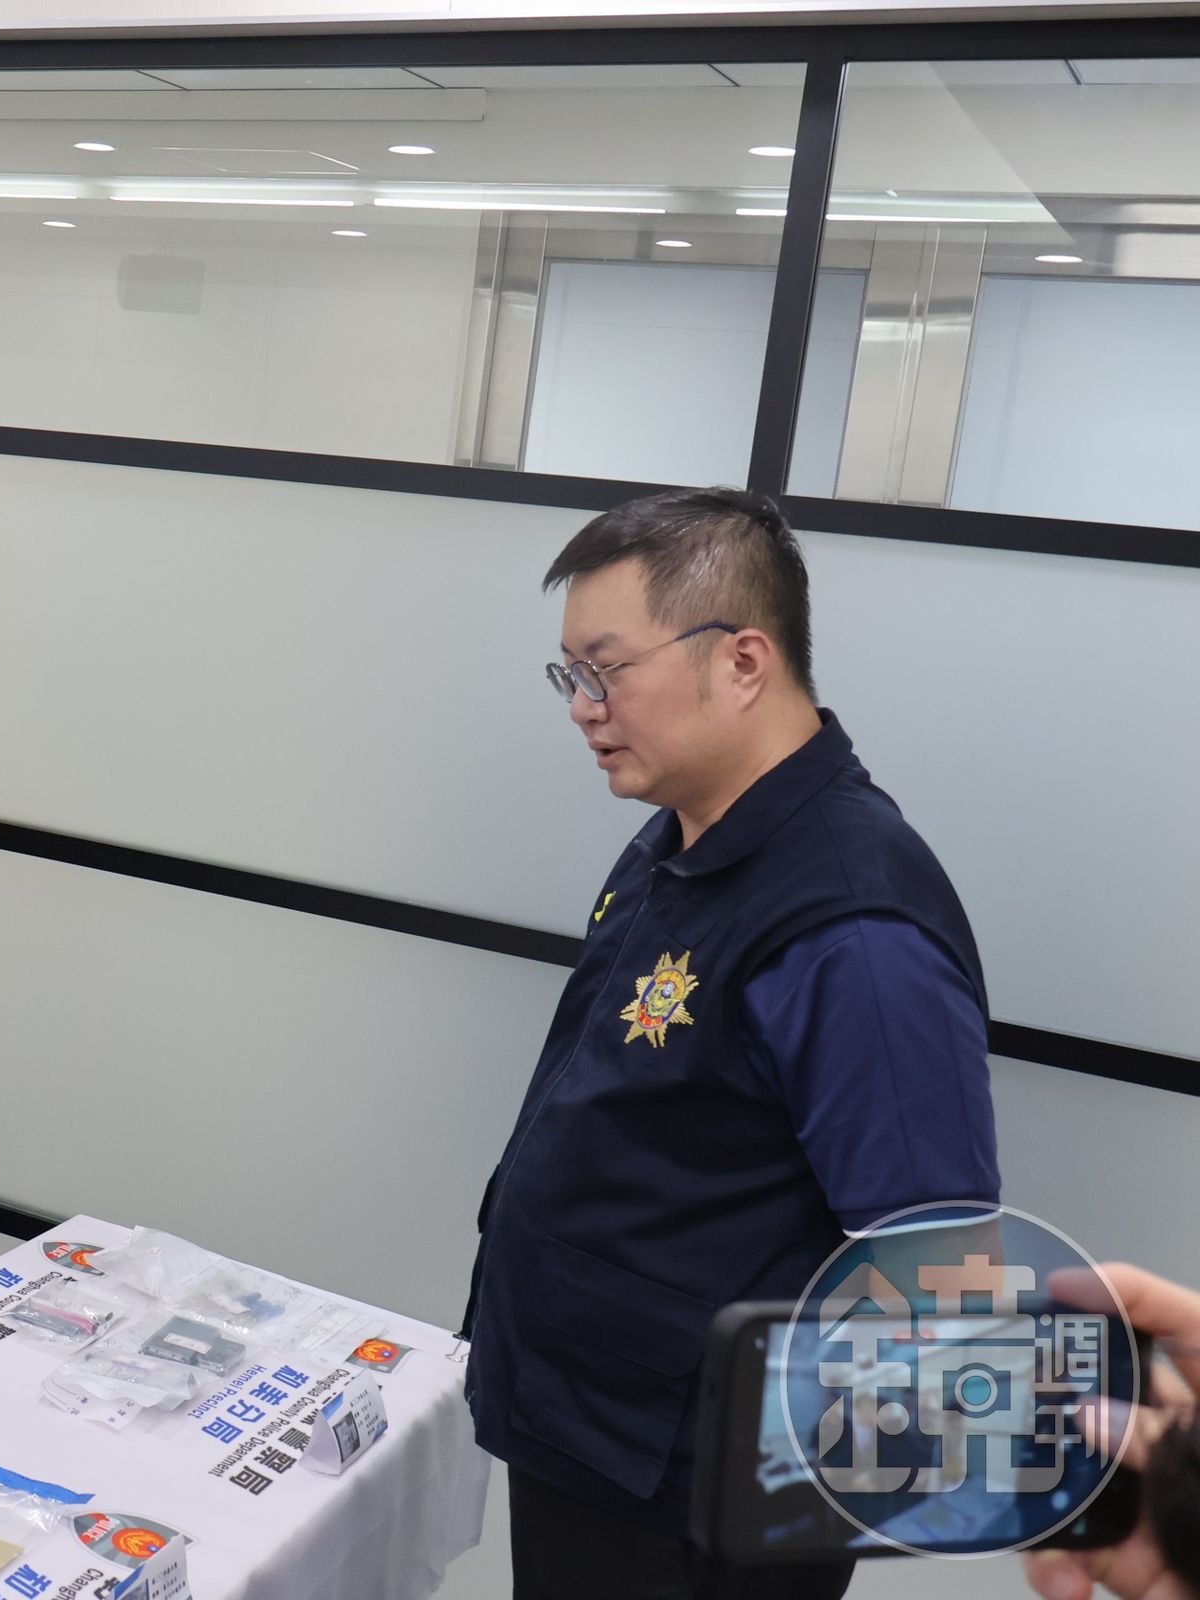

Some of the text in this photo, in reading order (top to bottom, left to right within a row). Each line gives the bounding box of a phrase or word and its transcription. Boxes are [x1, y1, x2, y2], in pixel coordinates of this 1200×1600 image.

[187, 1364, 267, 1419] Hemei Precinct
[201, 1365, 310, 1444] 和美分局
[207, 1368, 349, 1477] Changhua County Police Department
